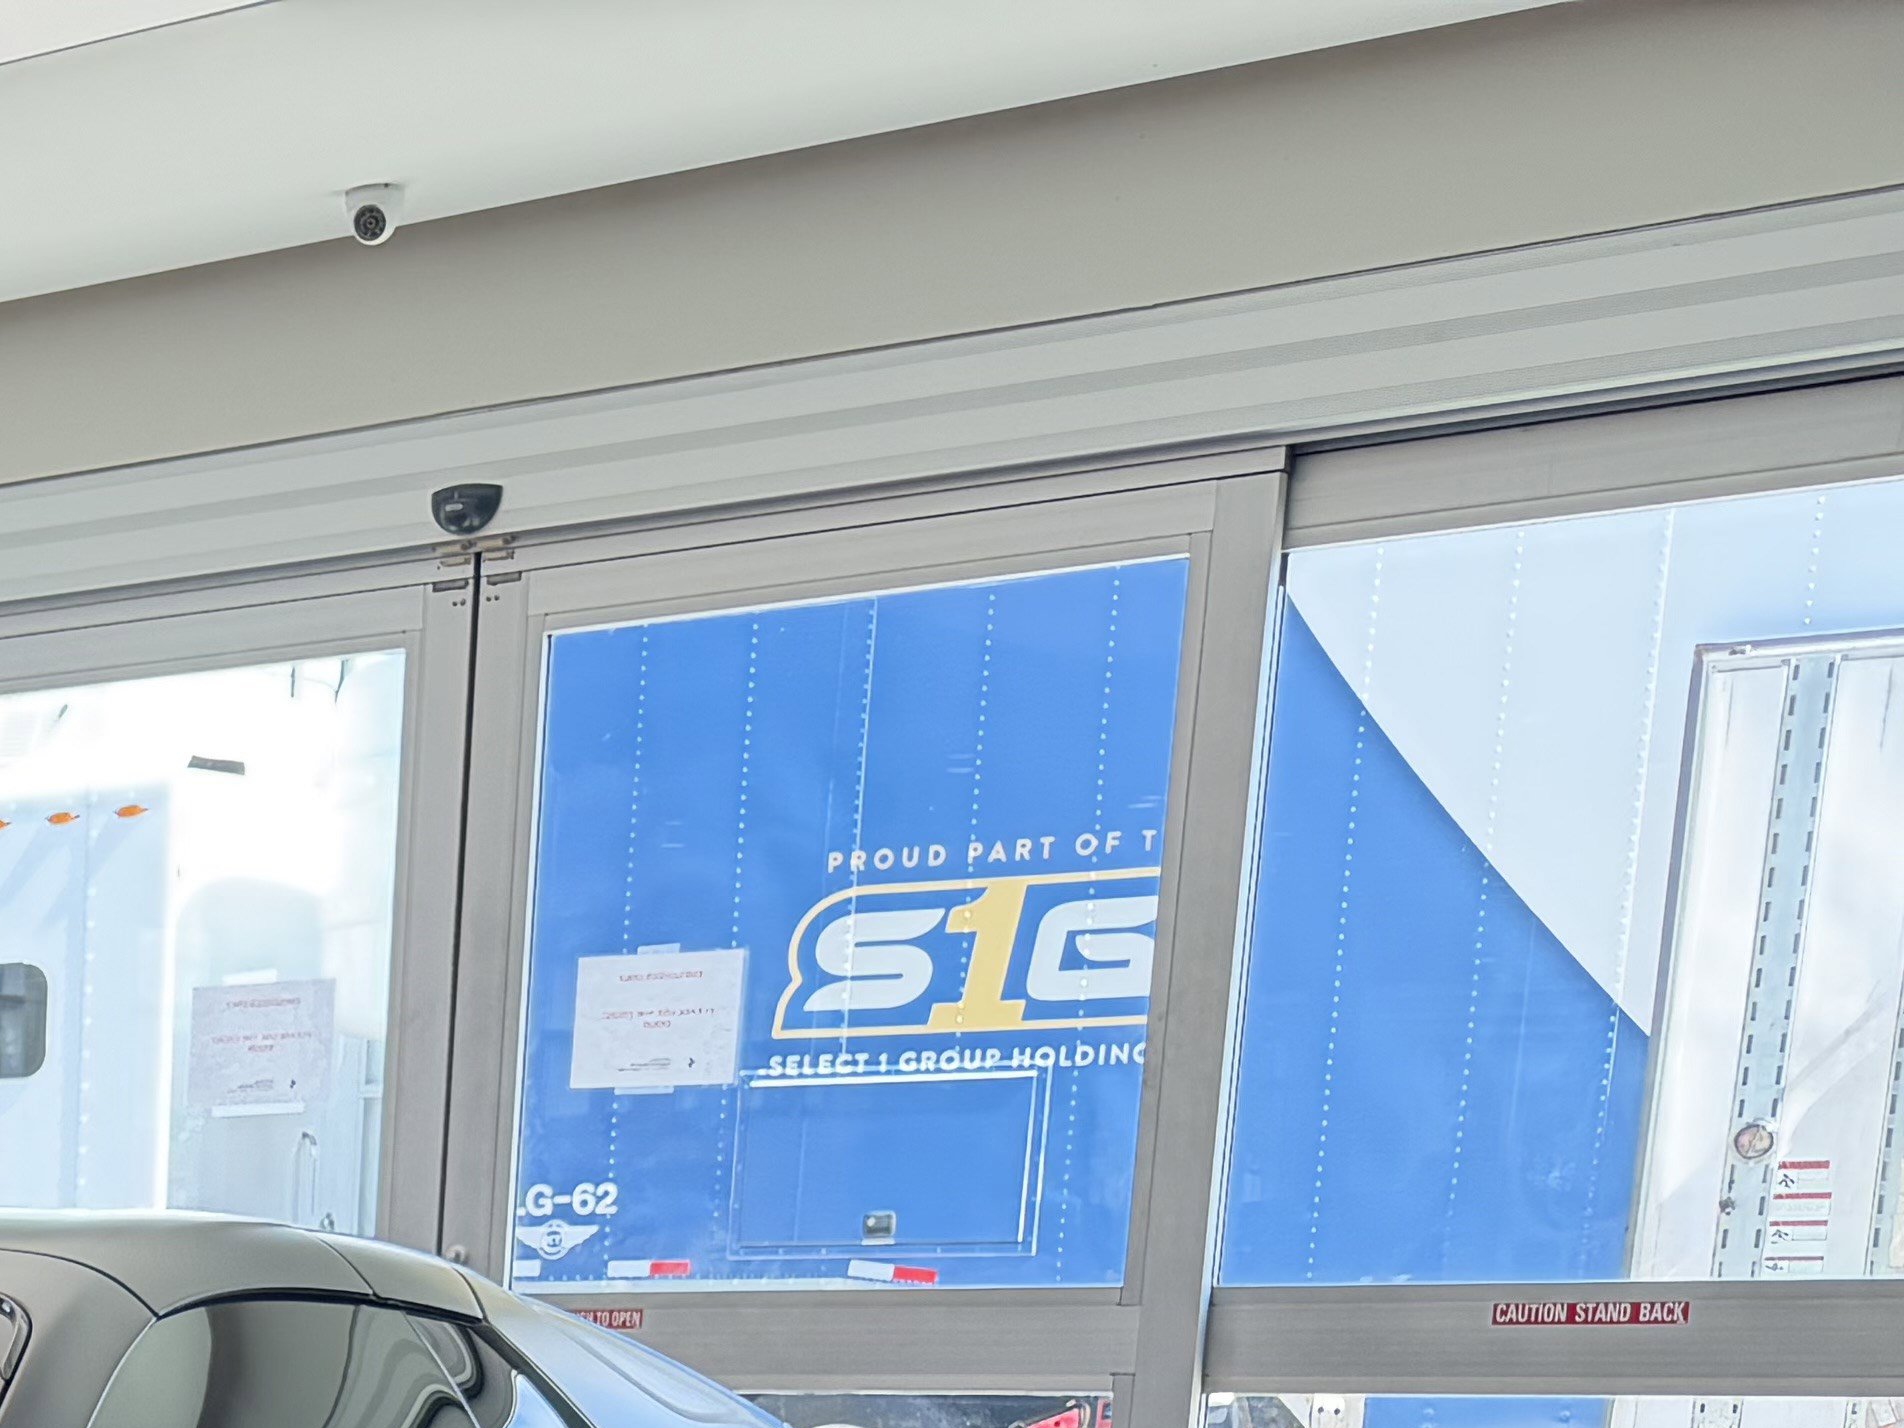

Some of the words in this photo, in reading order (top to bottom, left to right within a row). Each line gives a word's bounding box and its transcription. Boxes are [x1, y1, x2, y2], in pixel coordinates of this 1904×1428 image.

[826, 844, 948, 873] PROUD
[968, 836, 1056, 864] PART
[1075, 830, 1122, 857] OF
[769, 1053, 870, 1077] SELECT
[879, 1053, 889, 1073] 1
[899, 1048, 1002, 1071] GROUP
[596, 1311, 610, 1326] TO
[611, 1311, 641, 1328] OPEN
[1495, 1303, 1568, 1323] CAUTION
[1575, 1302, 1632, 1322] STAND
[1638, 1302, 1686, 1323] BACK
